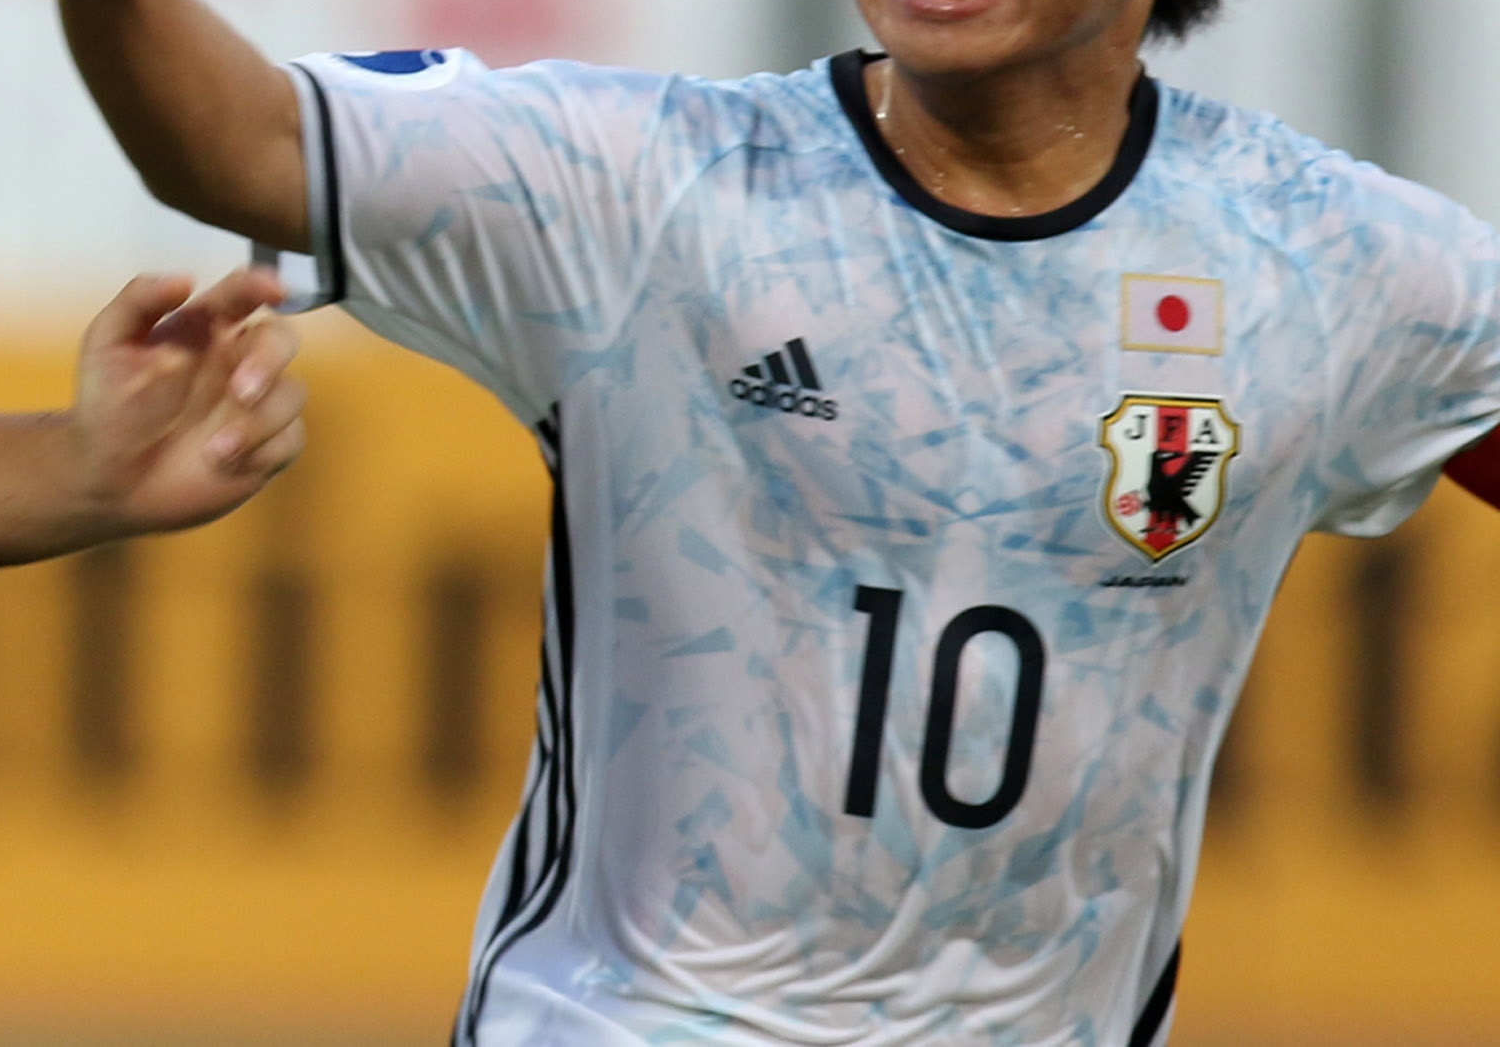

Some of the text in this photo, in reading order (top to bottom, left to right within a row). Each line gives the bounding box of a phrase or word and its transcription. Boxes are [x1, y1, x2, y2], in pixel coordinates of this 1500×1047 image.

[730, 379, 839, 421] adidas
[1123, 414, 1220, 445] JFA
[843, 584, 1047, 830] 10
